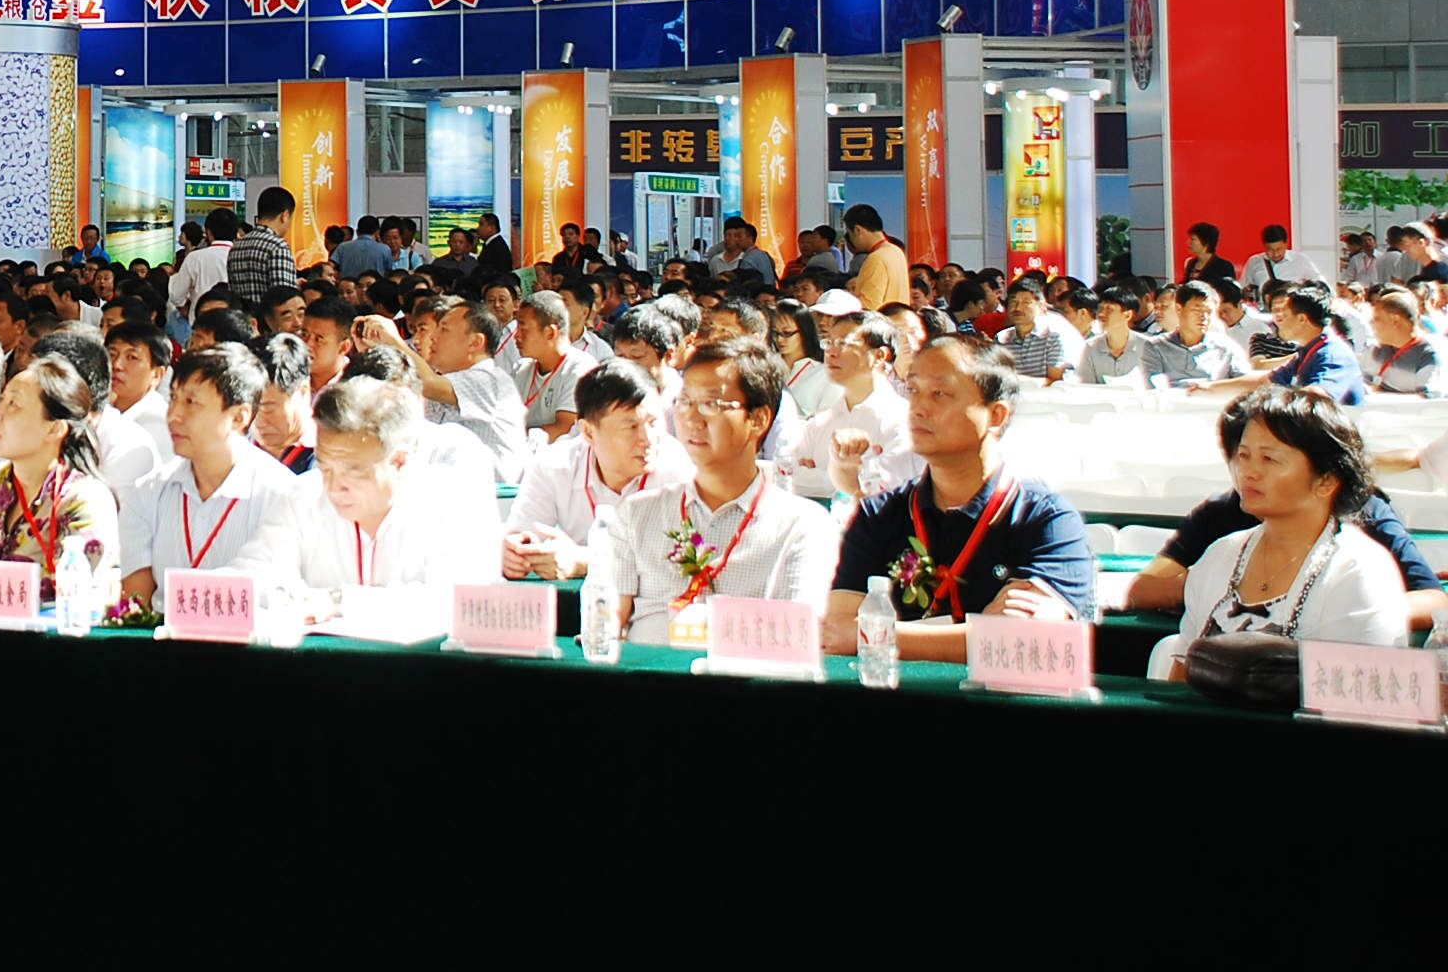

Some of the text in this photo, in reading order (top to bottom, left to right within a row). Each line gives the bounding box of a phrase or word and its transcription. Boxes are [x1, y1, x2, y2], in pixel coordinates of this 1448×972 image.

[312, 130, 334, 190] 创新
[555, 124, 574, 189] 发展
[768, 115, 788, 186] 合作
[303, 154, 313, 226] Innovation
[541, 150, 553, 245] Development
[759, 141, 770, 237] Cooperation
[979, 636, 1076, 676] 湖北省粮食局
[1311, 660, 1422, 708] 安徽省粮食局
